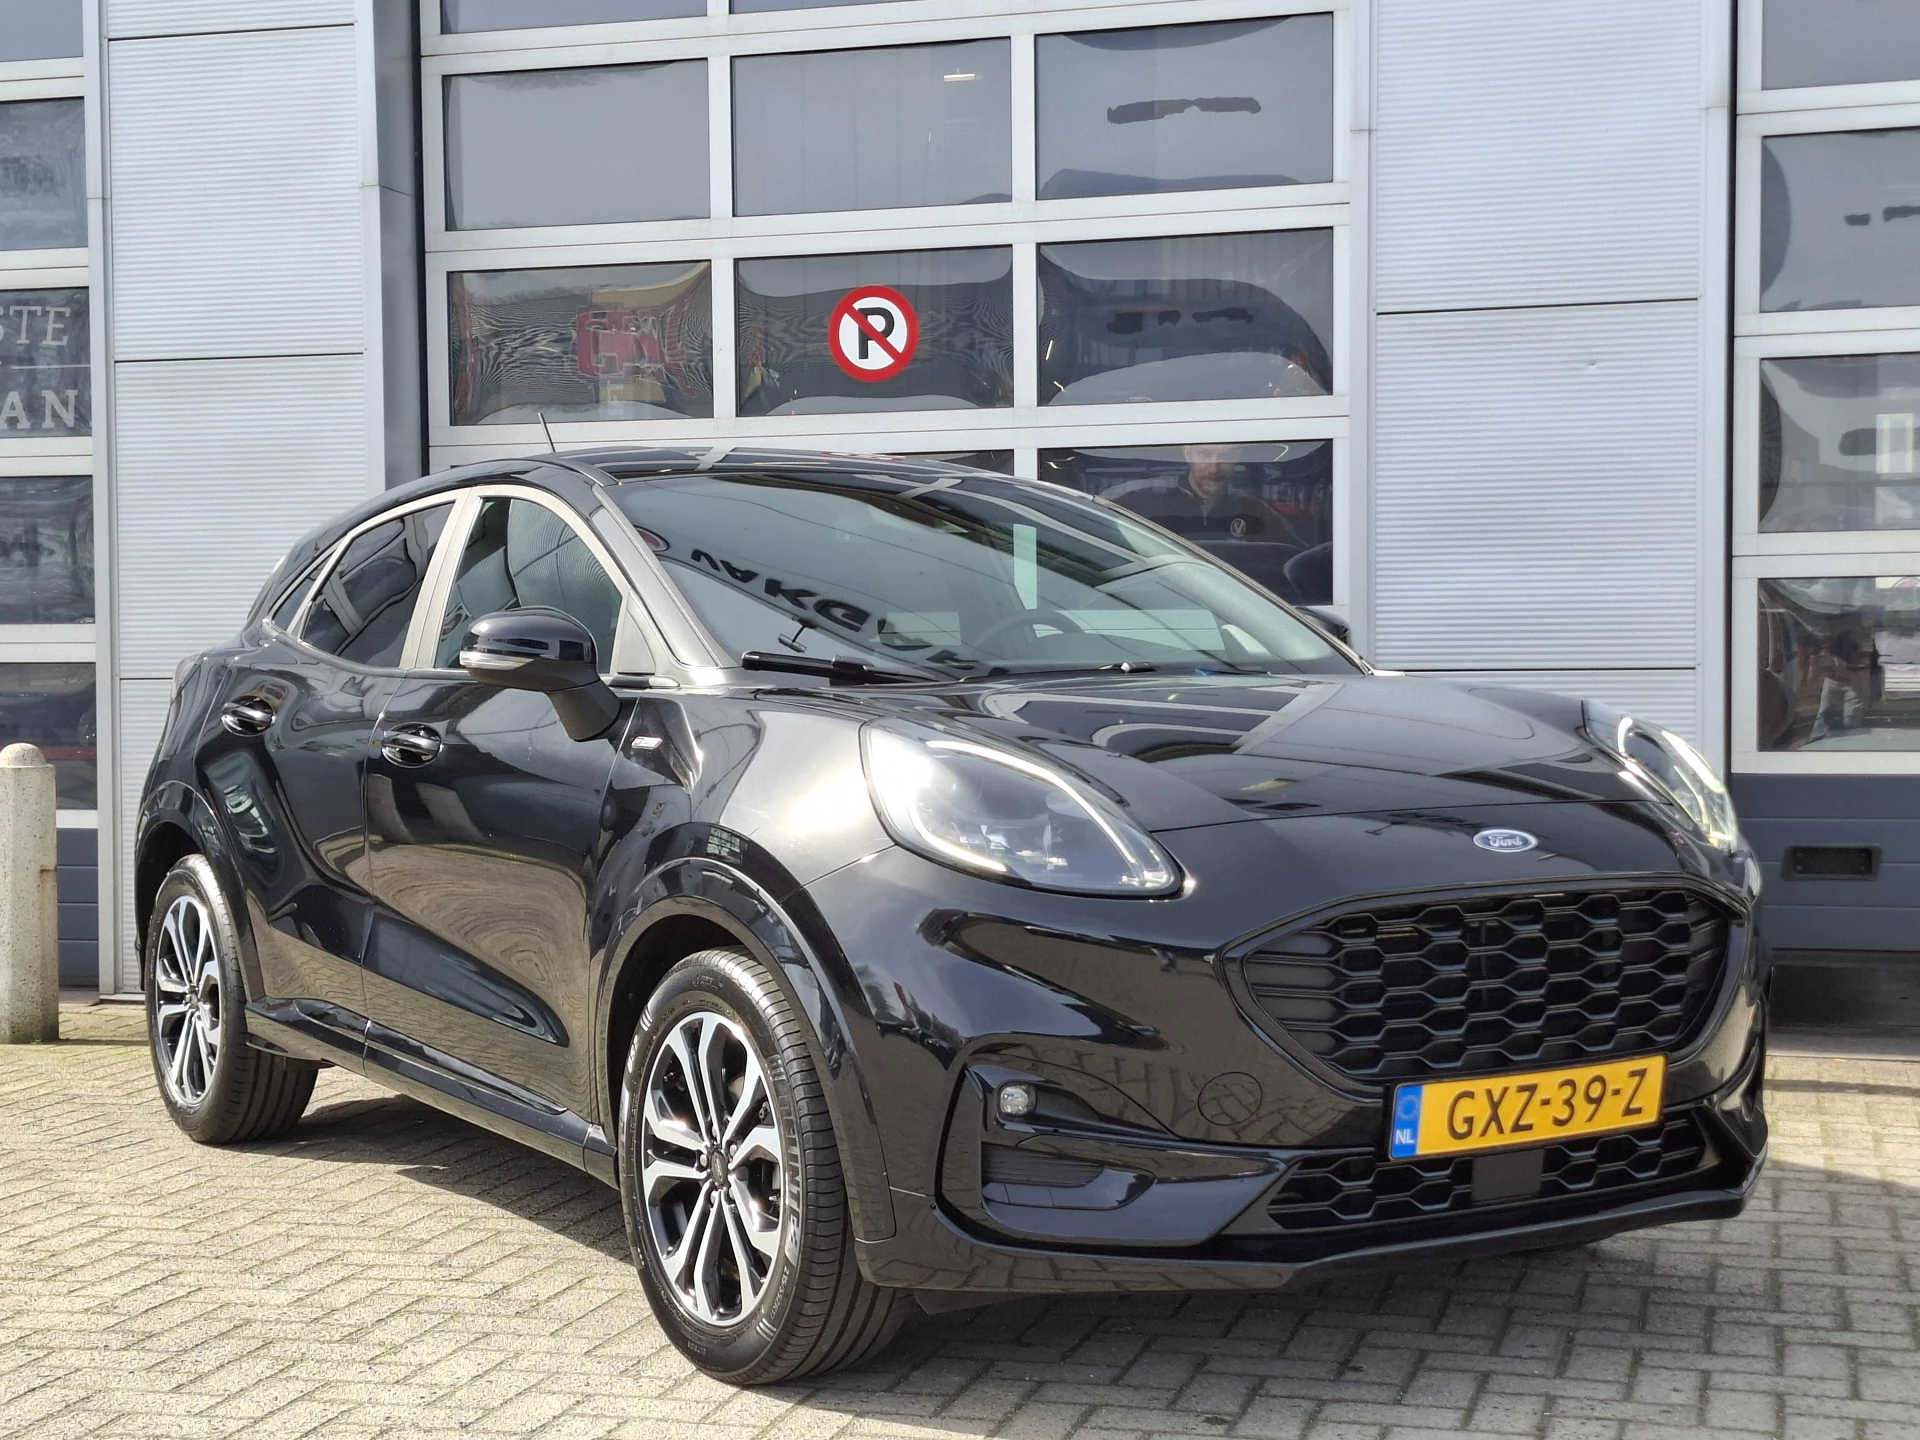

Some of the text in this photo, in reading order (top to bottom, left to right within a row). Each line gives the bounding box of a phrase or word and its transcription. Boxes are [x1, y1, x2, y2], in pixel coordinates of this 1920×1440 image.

[0, 305, 71, 346] TE
[1488, 834, 1522, 847] Ford
[1447, 1068, 1647, 1140] GXZ-39-Z
[1395, 1129, 1415, 1145] NL
